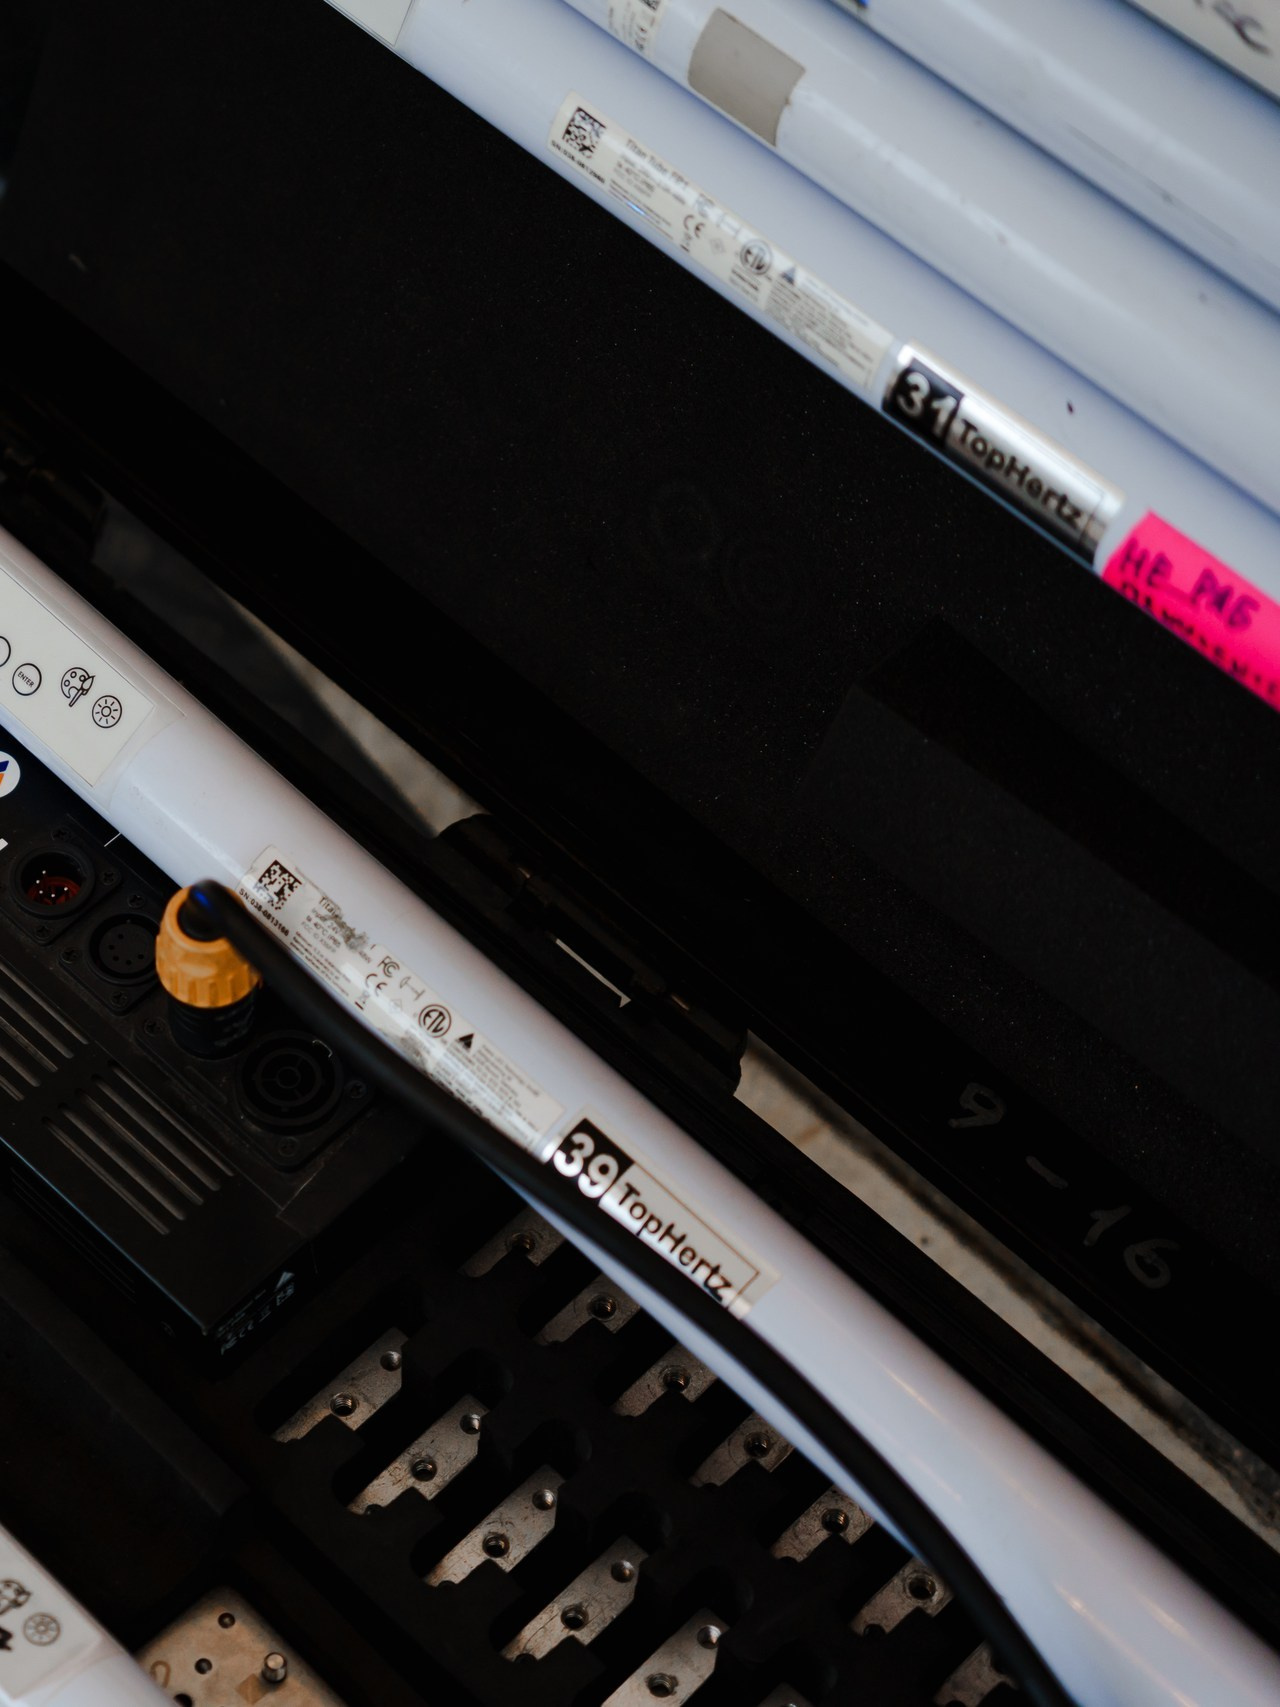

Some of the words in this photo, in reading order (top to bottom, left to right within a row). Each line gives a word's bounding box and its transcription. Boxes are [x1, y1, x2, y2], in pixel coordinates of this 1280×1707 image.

[898, 372, 959, 427] 31
[955, 420, 1083, 529] TopHertz
[17, 670, 35, 688] ENTER
[365, 973, 388, 997] CE
[552, 1132, 618, 1200] 39
[615, 1182, 733, 1302] TopHertz
